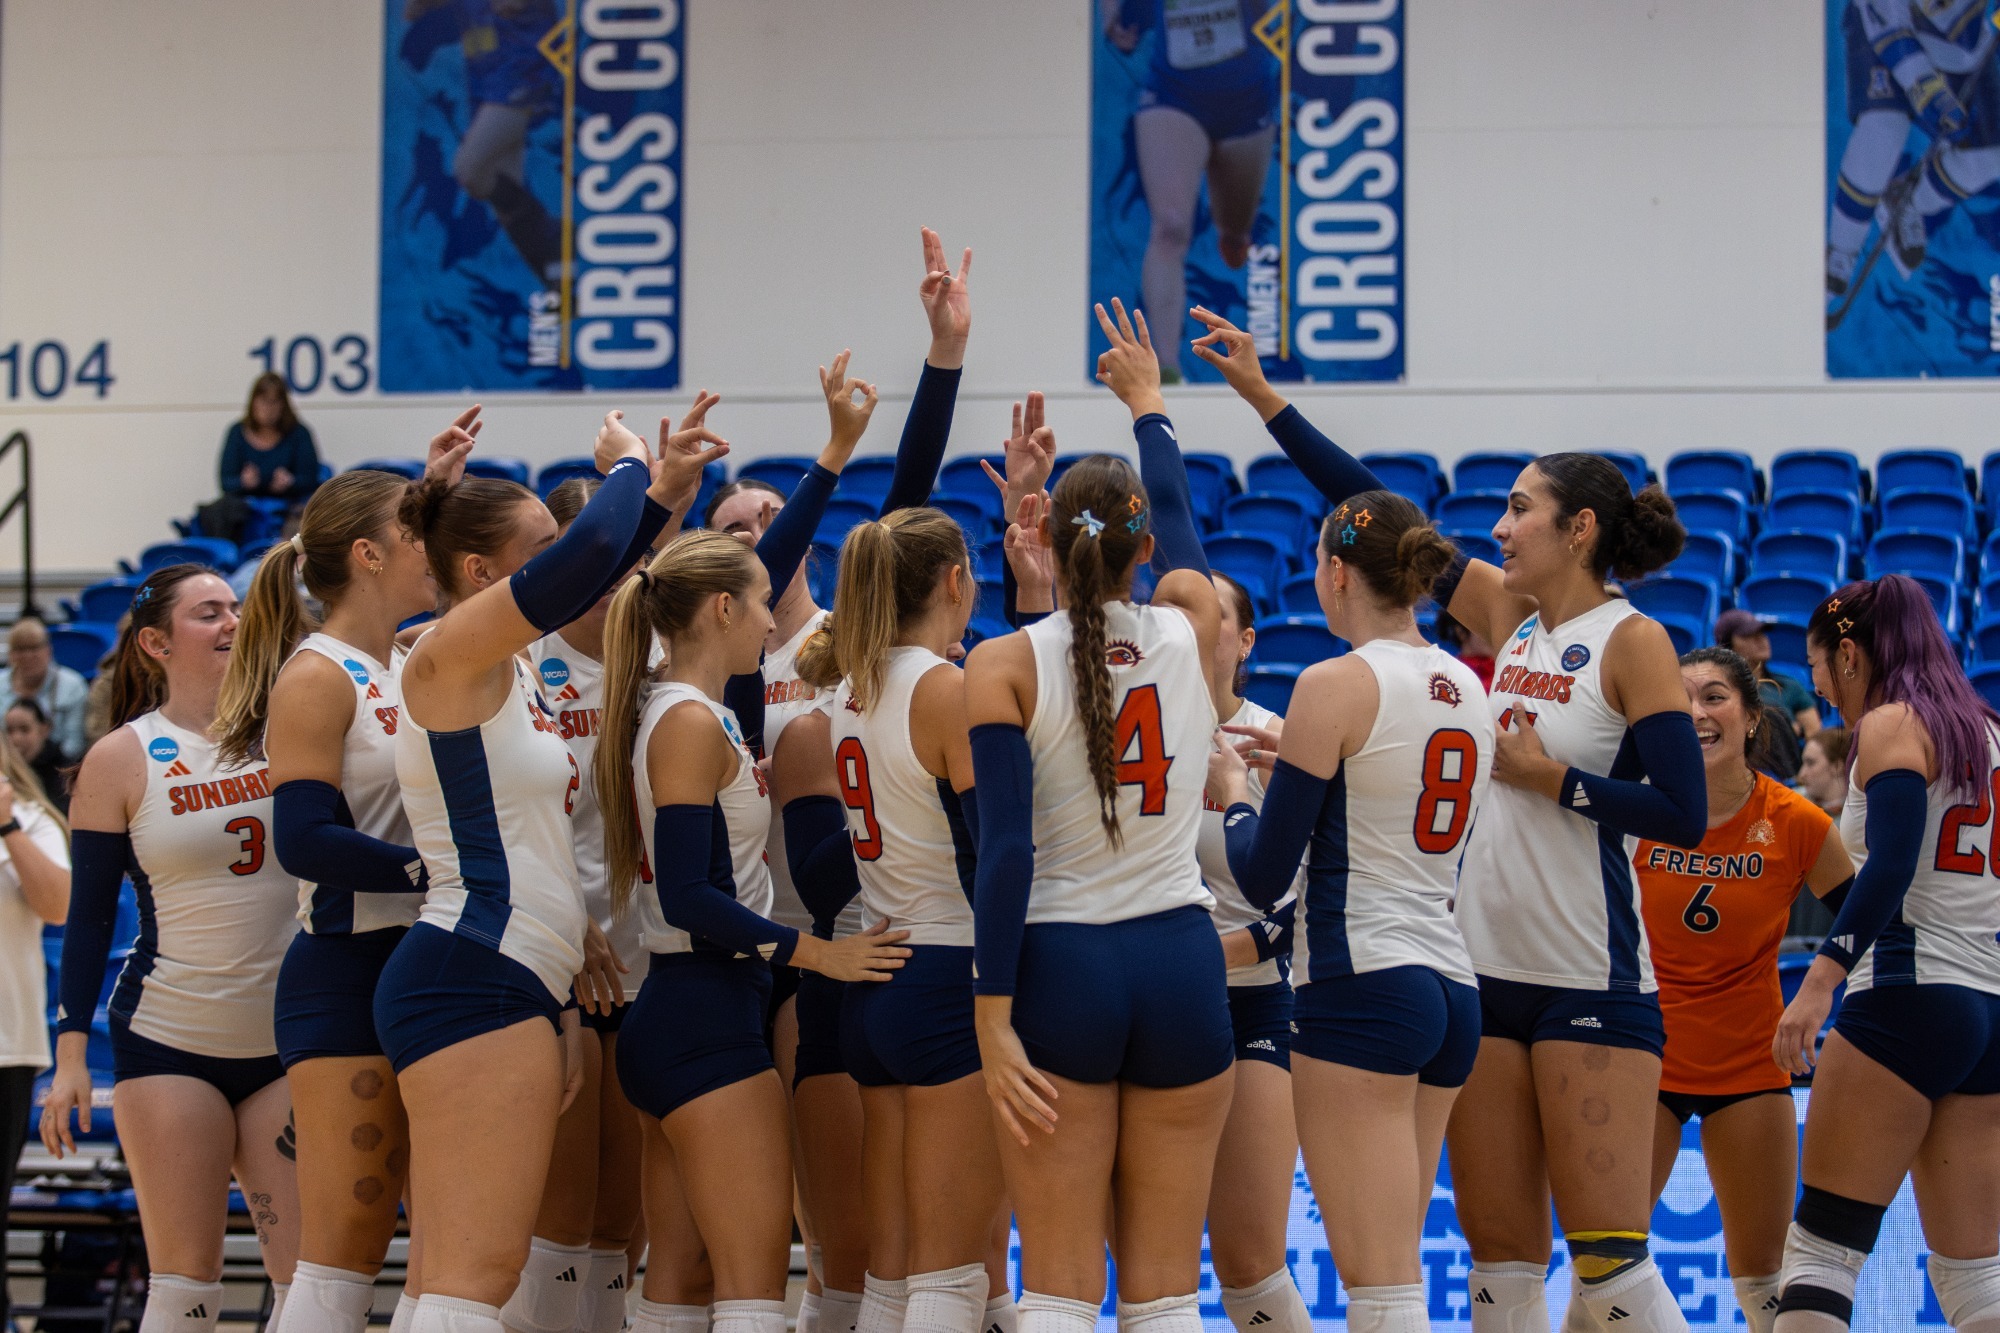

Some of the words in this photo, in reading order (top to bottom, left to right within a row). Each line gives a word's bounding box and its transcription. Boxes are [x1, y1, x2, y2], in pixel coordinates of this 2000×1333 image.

[575, 111, 677, 370] CROSS
[1296, 98, 1398, 361] CROSS
[528, 291, 560, 366] MEN'S
[1247, 244, 1279, 358] WOMEN'S
[0, 340, 116, 400] 104
[248, 334, 370, 395] 103
[543, 670, 569, 680] NCAA
[1114, 683, 1175, 816] 4
[836, 737, 883, 862] 9
[1413, 728, 1478, 855] 8
[1933, 764, 2000, 880] 2
[224, 816, 266, 876] 3
[1648, 846, 1764, 880] FRESNO
[1682, 883, 1721, 934] 6
[1246, 1040, 1276, 1052] adidas
[1571, 1018, 1602, 1029] adidas
